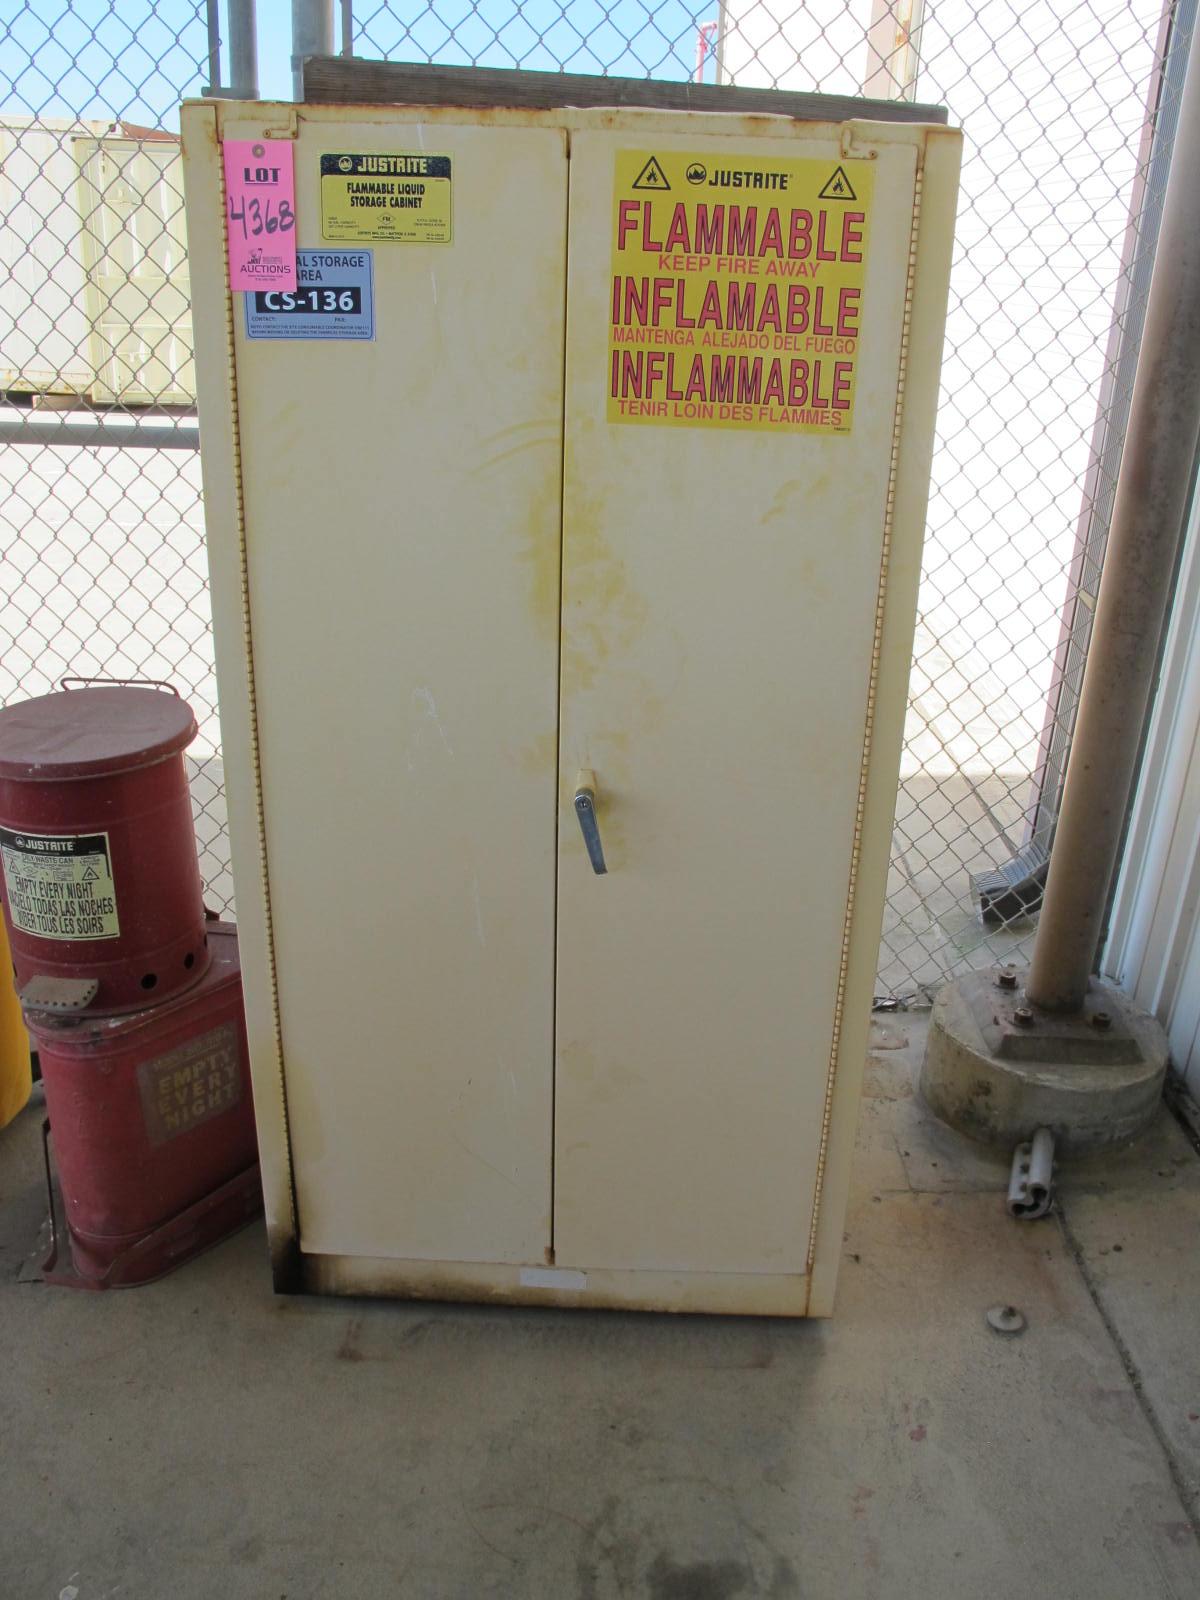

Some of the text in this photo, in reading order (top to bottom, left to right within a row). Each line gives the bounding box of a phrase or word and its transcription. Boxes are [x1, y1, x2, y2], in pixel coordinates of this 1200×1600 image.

[357, 156, 427, 173] JUSTRITE
[244, 168, 281, 182] LOT
[708, 170, 788, 190] JUSTRITE
[347, 182, 426, 195] FLAMMABLE LIQUID
[350, 196, 423, 209] STORAGE CABINET
[230, 195, 295, 240] 4368
[617, 200, 865, 263] FLAMMABLE
[240, 264, 291, 273] AUCTIONS
[311, 255, 365, 268] STORAGE
[658, 254, 821, 279] KEEP FIRE AWAY
[265, 291, 354, 311] CS-136
[612, 276, 861, 337] INFLAMABLE
[613, 327, 856, 355] MANTENGA ALEJADO DEL FUEGO
[611, 350, 853, 409] INFLAMMABLE
[618, 399, 842, 426] TENIR LOIN DES FLAMMES
[25, 839, 74, 851] JUSTRITE
[15, 876, 93, 899] EMPTY EVERY NIGHT
[32, 897, 58, 916] TODAS
[59, 900, 76, 917] LAS
[79, 898, 114, 916] NOCHES
[37, 915, 58, 933] TOUS
[60, 917, 75, 934] LES
[77, 918, 104, 934] SOIRS
